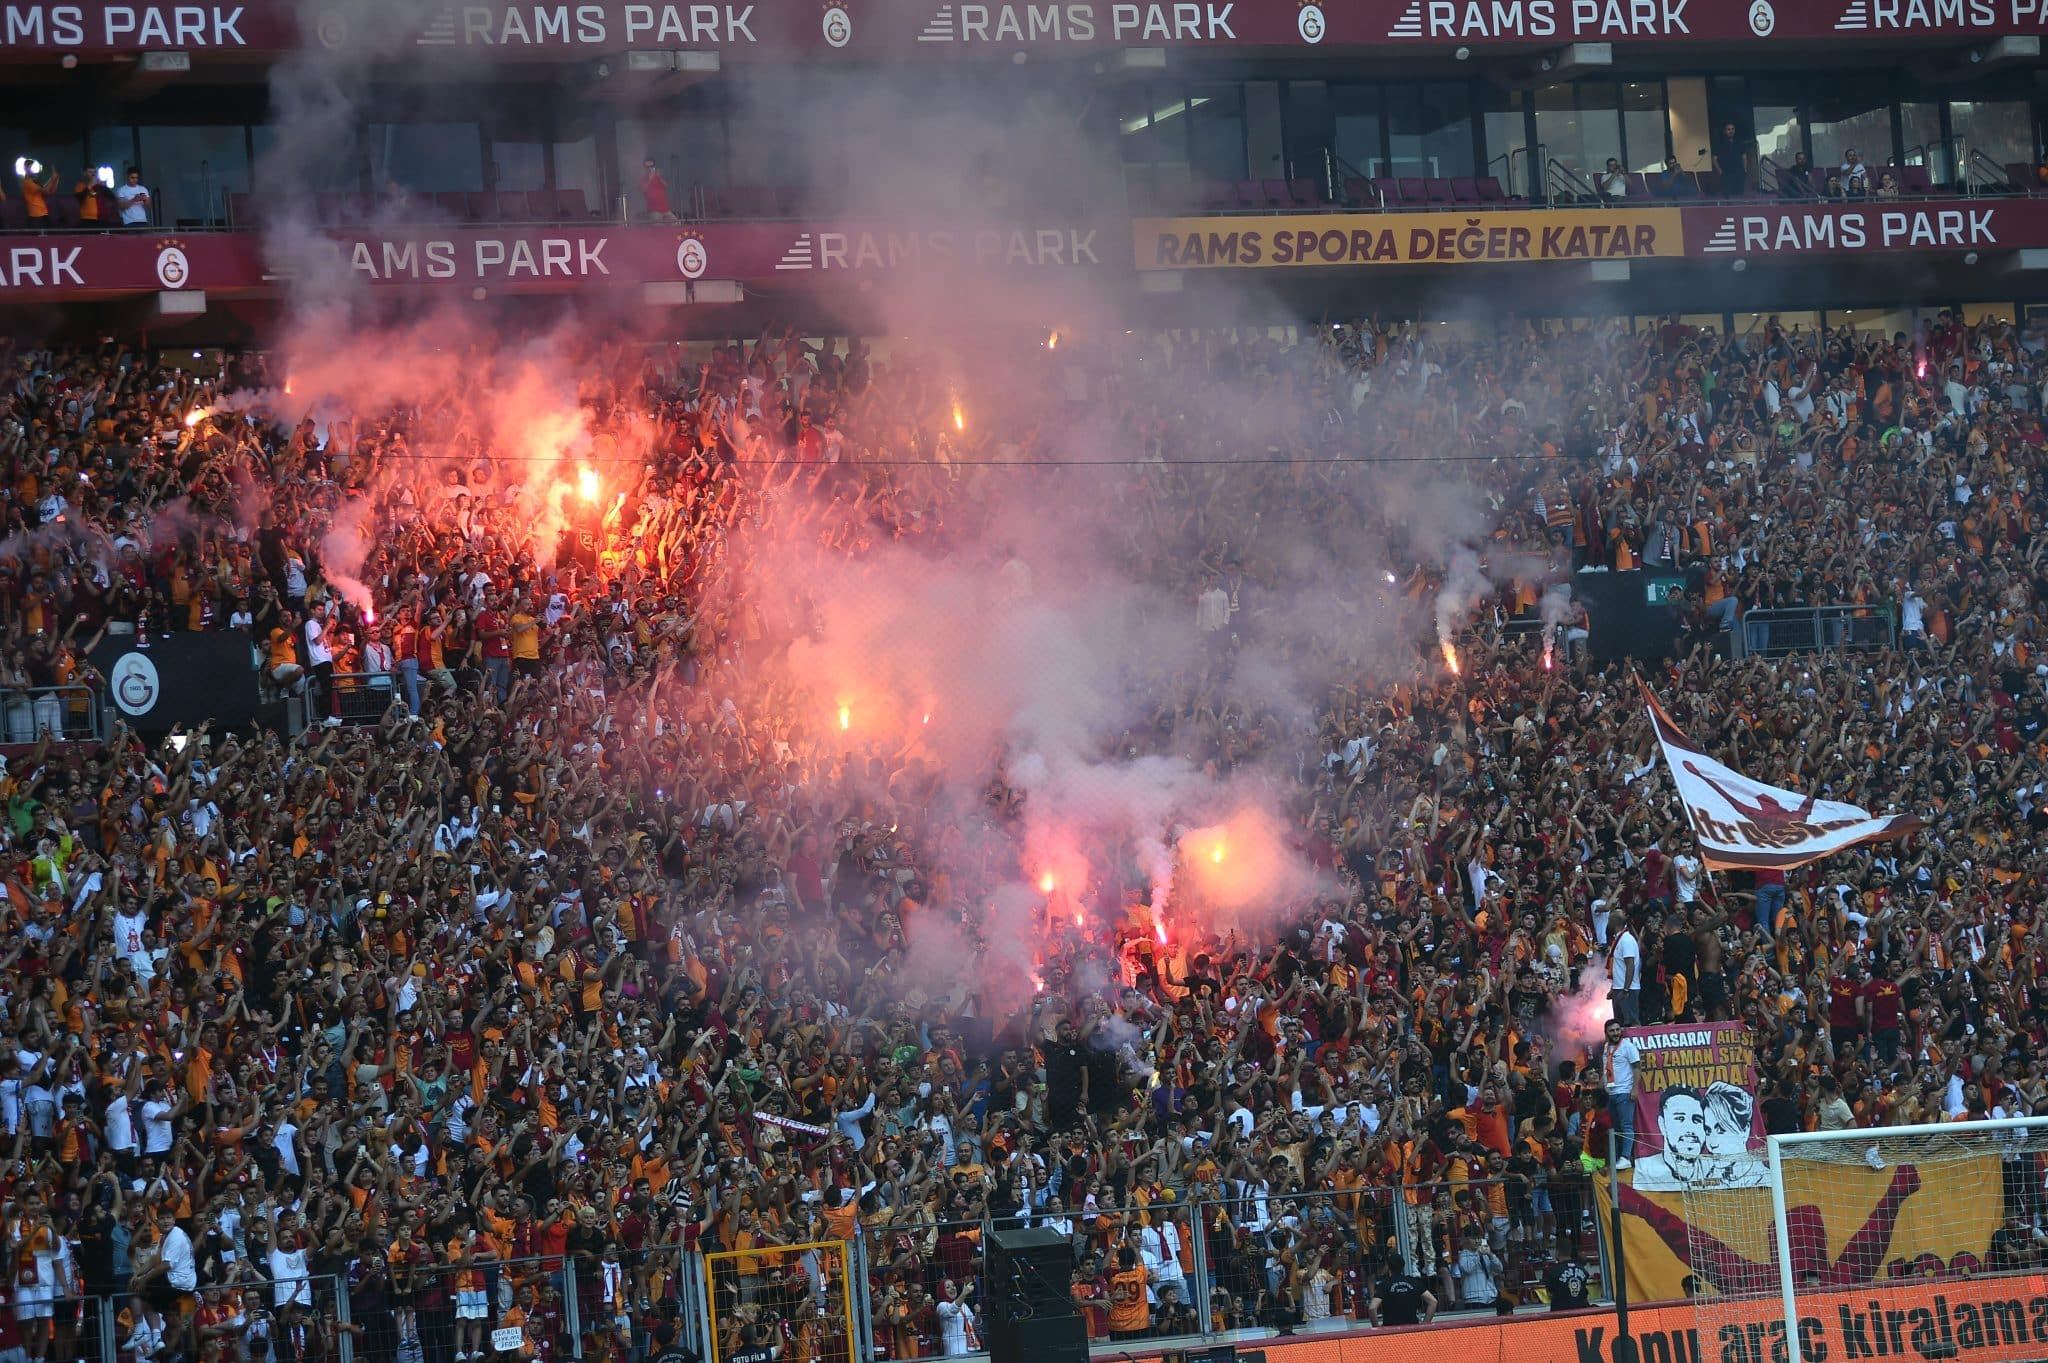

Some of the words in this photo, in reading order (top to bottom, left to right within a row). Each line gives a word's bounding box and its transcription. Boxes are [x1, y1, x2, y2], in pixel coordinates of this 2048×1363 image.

[0, 6, 84, 45] MS
[104, 6, 247, 45] PARK
[463, 5, 606, 44] RAMS
[625, 5, 757, 42] PARK
[961, 4, 1095, 41] RAMS
[1112, 3, 1237, 40] PARK
[1429, 1, 1556, 37] RAMS
[1572, 0, 1690, 35] PARK
[1873, 0, 1995, 28] RAMS
[2011, 0, 2048, 25] P
[973, 229, 1101, 266] PARK
[1156, 230, 1261, 264] RAMS
[1271, 228, 1398, 263] SPORA
[1408, 218, 1531, 260] DEĞER
[1541, 224, 1656, 258] KATAR
[1743, 213, 1866, 250] RAMS
[1881, 209, 1997, 247] PARK
[0, 246, 85, 286] RK
[318, 240, 457, 279] AMS
[475, 238, 610, 277] PARK
[1640, 1050, 1657, 1070] ER
[1663, 1048, 1713, 1067] ZAMAN
[1640, 1064, 1750, 1093] YANINIZDA!
